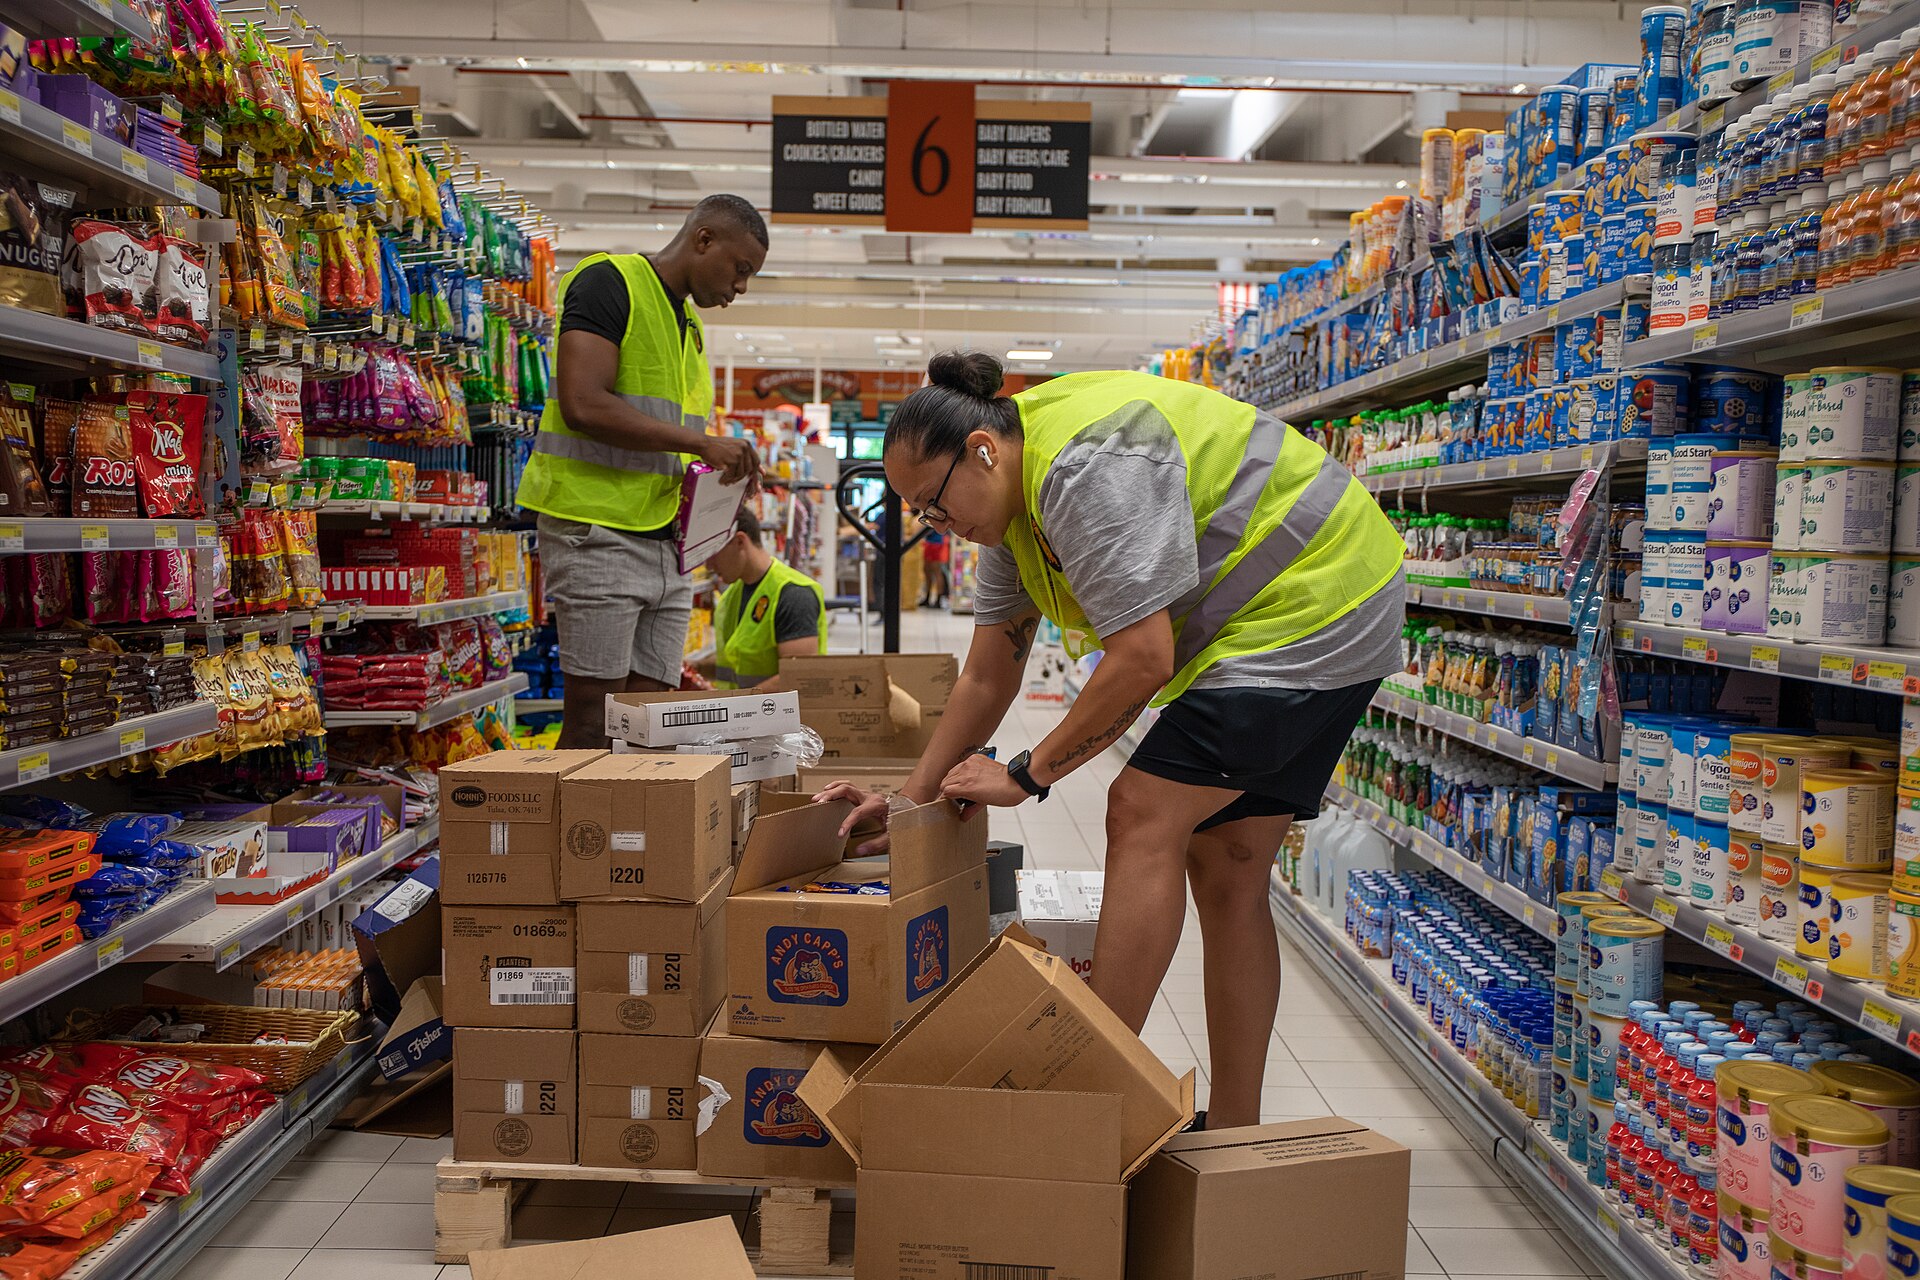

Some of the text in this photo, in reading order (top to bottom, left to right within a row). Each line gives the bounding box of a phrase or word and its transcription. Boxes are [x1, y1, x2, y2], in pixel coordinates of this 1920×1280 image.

[1753, 10, 1772, 20] Start
[1713, 36, 1729, 46] Start
[806, 120, 885, 139] BOTTLED WATER
[977, 124, 1052, 144] BABY DIAPERS
[783, 144, 885, 164] COOKIES/CRACKERS
[911, 115, 950, 197] 6
[977, 148, 1070, 168] BABY NEEDS/CARE
[848, 170, 884, 188] CANDY
[977, 172, 1033, 190] BABY FOOD
[1698, 173, 1715, 188] good
[43, 188, 68, 204] SHARE
[812, 192, 884, 212] SWEET GOODS
[1658, 190, 1675, 202] good
[1695, 192, 1717, 204] ntlePro
[976, 196, 1052, 215] BABY FORMULA
[1656, 208, 1677, 216] ntlePro
[0, 243, 61, 271] NUGGET
[1657, 281, 1678, 296] good
[1689, 290, 1704, 299] tlePro
[260, 374, 298, 395] HARIBO
[1651, 452, 1668, 461] Start
[1690, 448, 1714, 458] Start
[338, 482, 363, 490] Trident
[1648, 545, 1665, 554] Start
[1687, 544, 1706, 555] Star
[451, 640, 481, 672] Skittles
[1648, 731, 1664, 741] Start
[1710, 764, 1730, 776] goo
[1680, 780, 1686, 792] 1
[1700, 779, 1724, 790] Gentle
[454, 791, 485, 802] NONNI'S
[488, 792, 541, 804] FOODS LLC
[486, 805, 542, 815] Tulsa, OK 74115
[1640, 812, 1656, 822] Start
[1671, 856, 1684, 866] Soy
[1694, 850, 1711, 861] good
[212, 848, 238, 878] Cards
[467, 872, 507, 884] 1126776
[1700, 868, 1715, 880] Soy
[913, 918, 944, 961] ANDY CAPP'S
[771, 932, 844, 970] ANDY CAPP'S
[498, 958, 530, 967] PLANTERS
[497, 972, 524, 980] 01869
[664, 954, 681, 992] 3220
[408, 1026, 442, 1060] Fisher
[750, 1076, 780, 1108] ANDY
